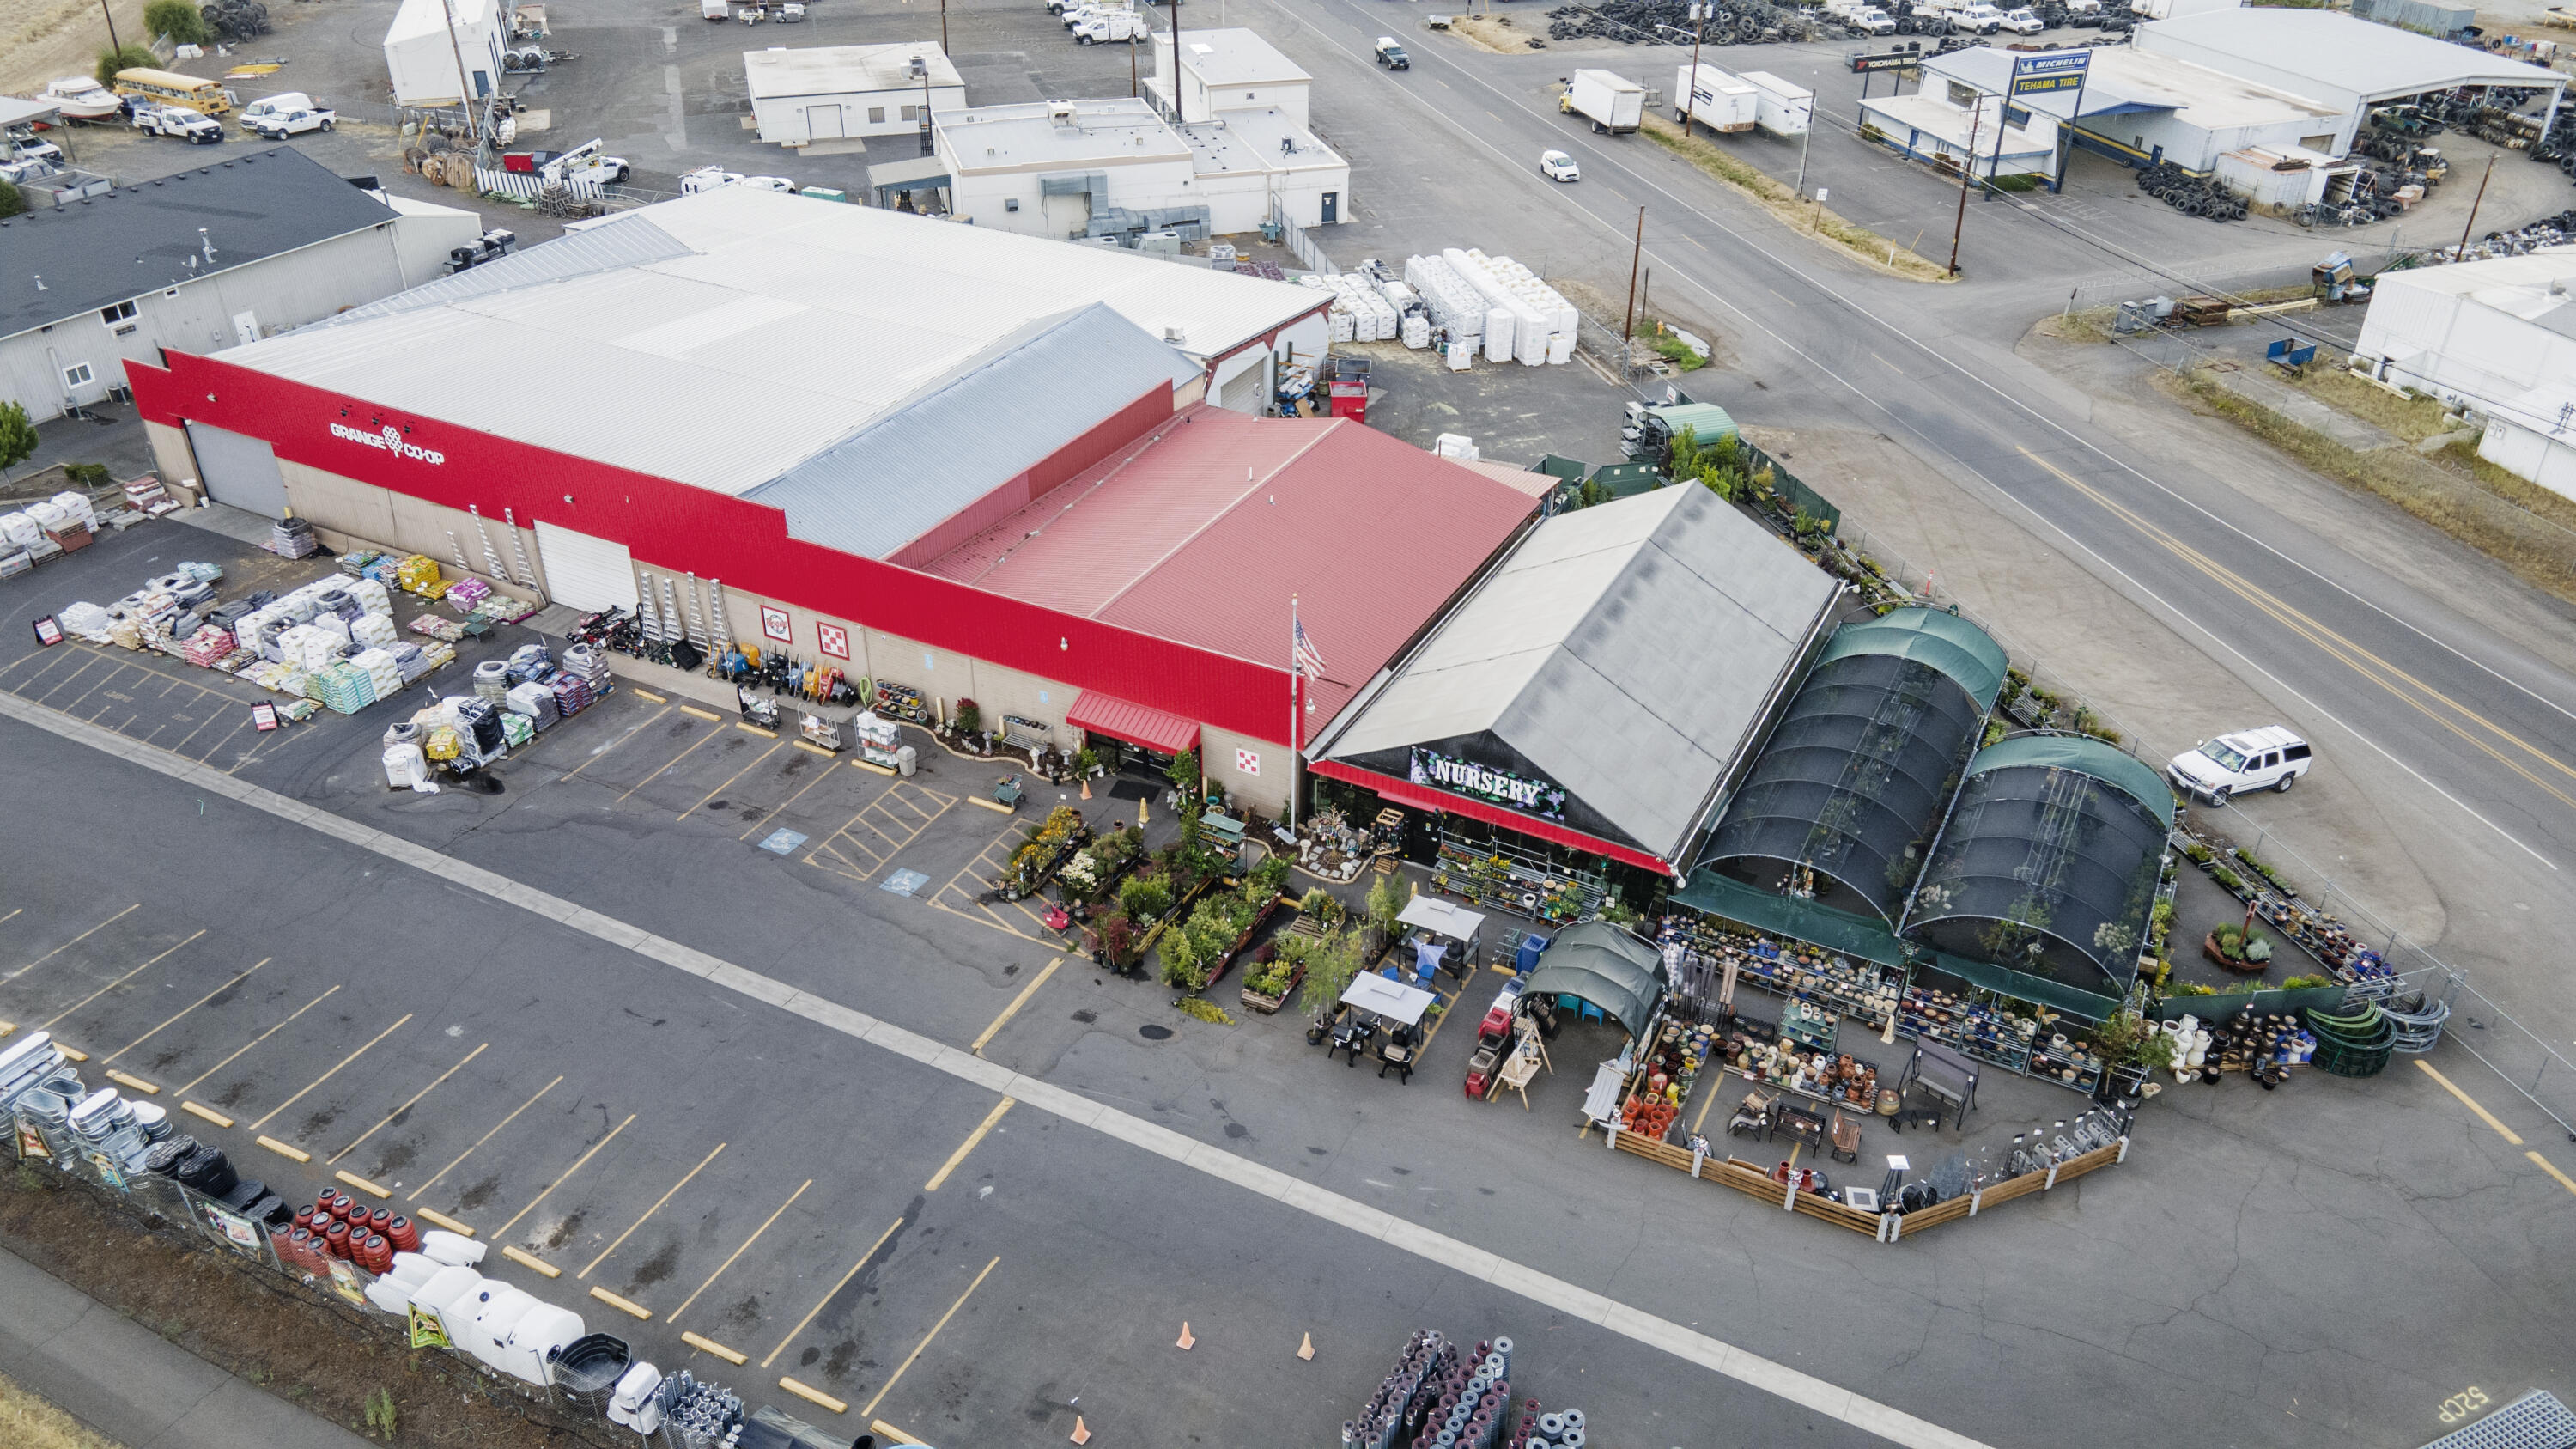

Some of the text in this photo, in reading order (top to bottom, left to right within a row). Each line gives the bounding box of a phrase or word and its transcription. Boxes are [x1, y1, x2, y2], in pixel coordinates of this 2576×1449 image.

[1868, 58, 1901, 68] YOKOHAMA
[2035, 57, 2087, 69] MICHELIN
[2020, 76, 2079, 91] TEHAMA TIRE
[330, 423, 445, 465] GRANGE CO-OP
[1435, 759, 1540, 805] NURSERY
